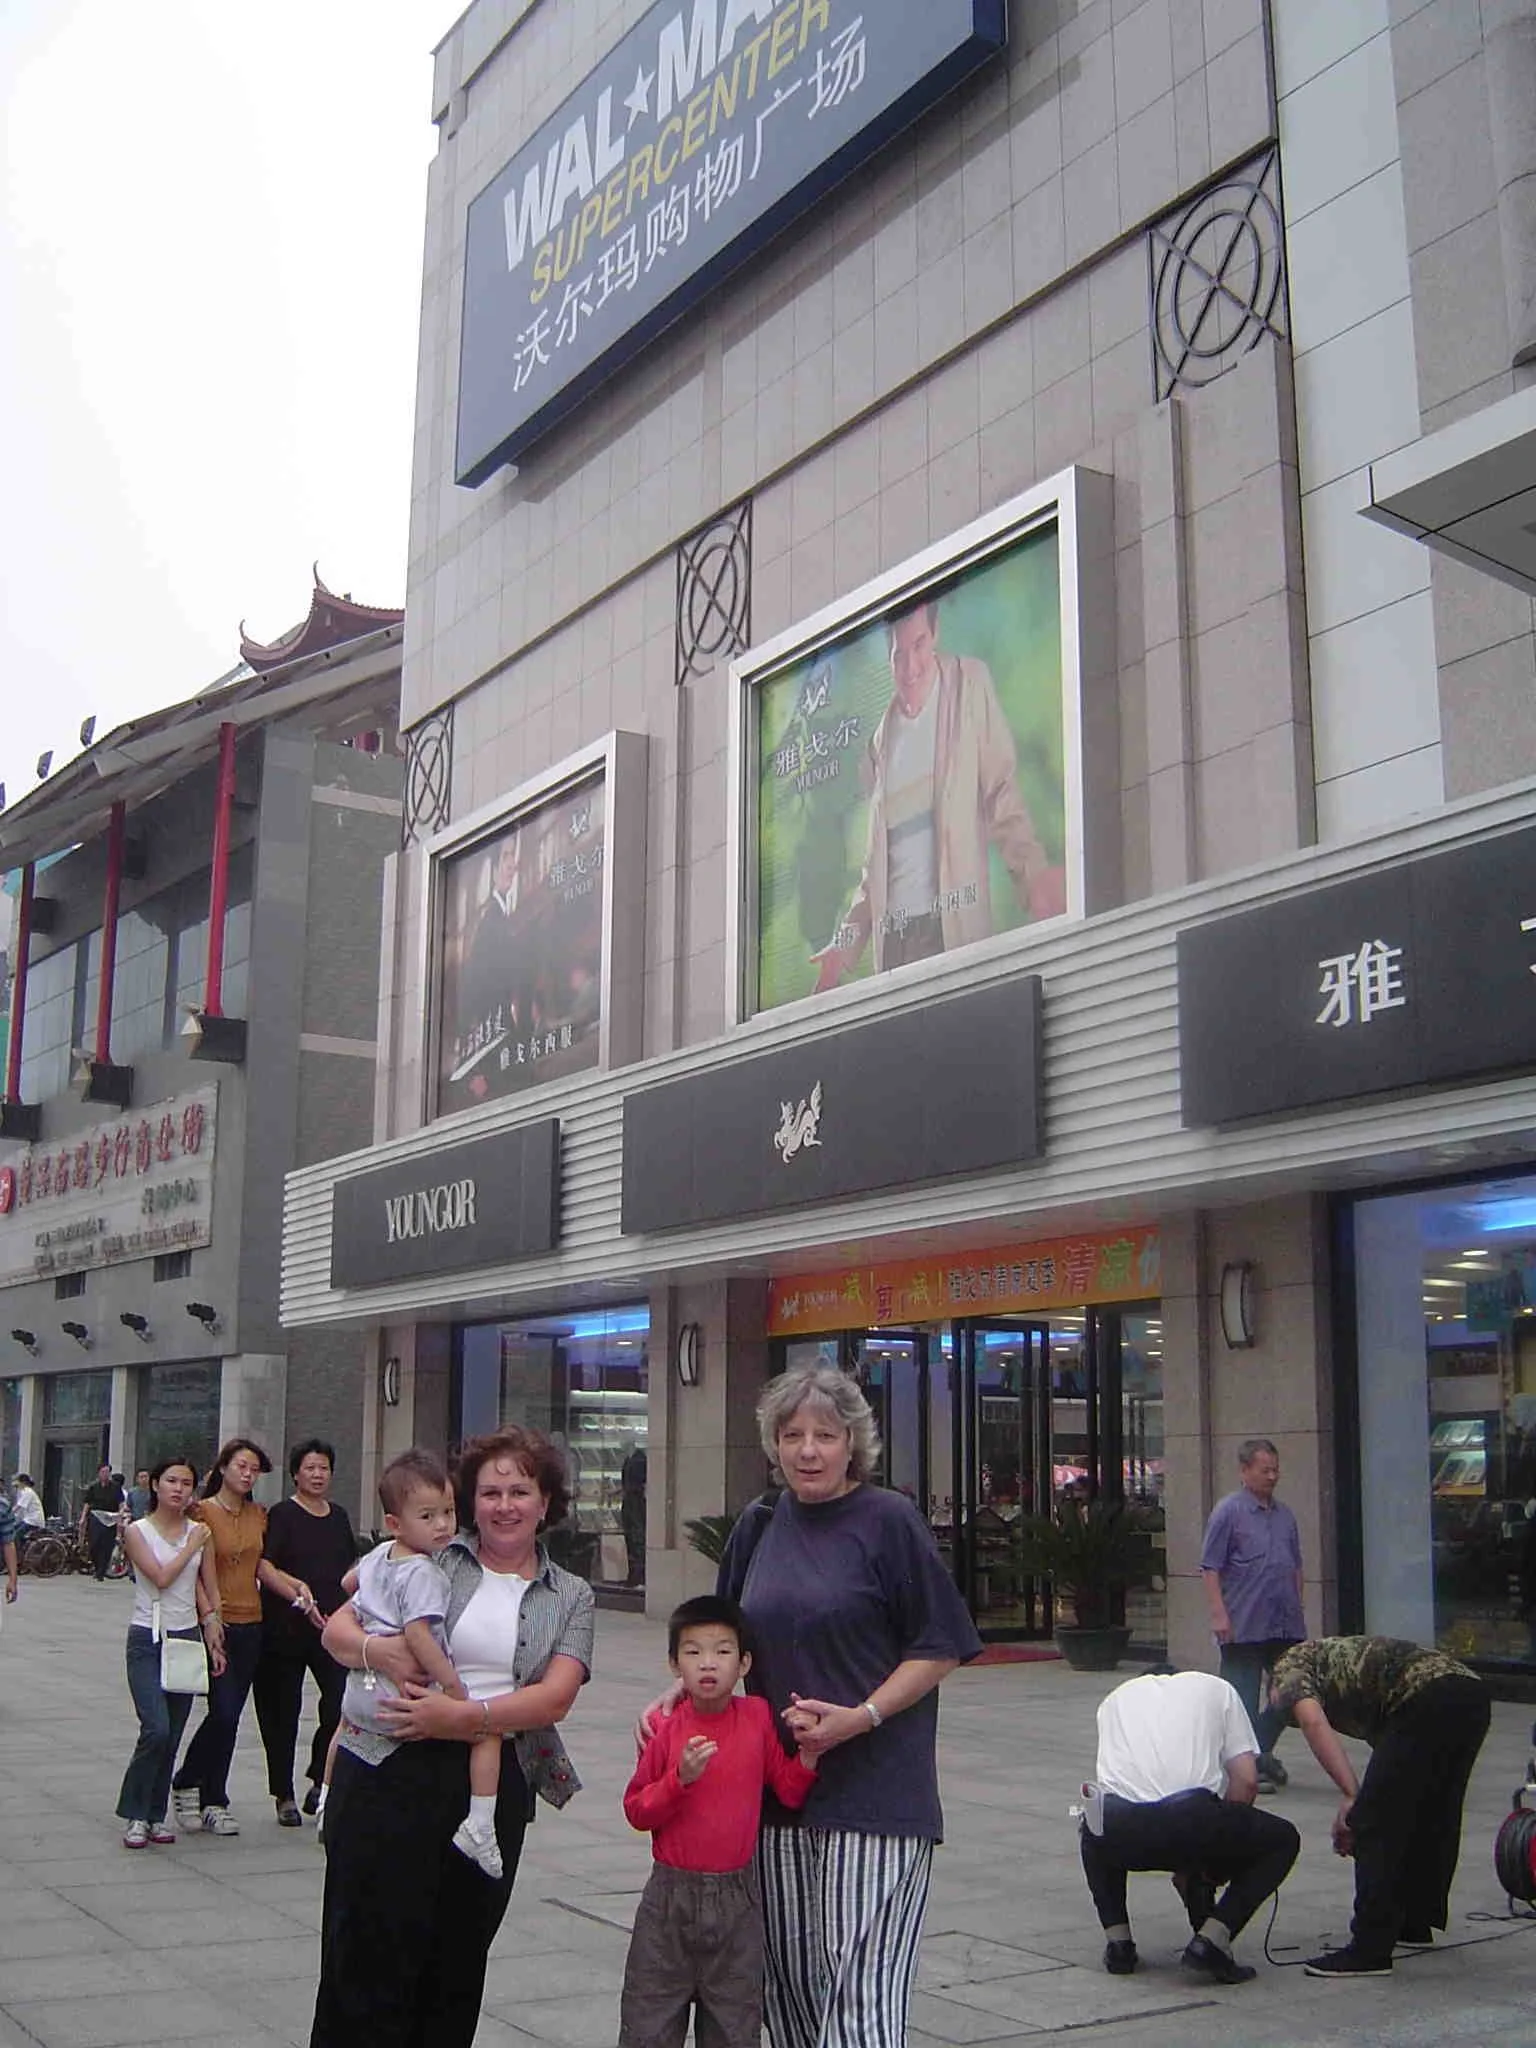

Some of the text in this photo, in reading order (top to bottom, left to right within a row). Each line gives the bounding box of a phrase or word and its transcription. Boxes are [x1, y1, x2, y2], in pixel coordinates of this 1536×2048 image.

[513, 15, 866, 392] 沃尔玛购物广场
[531, 0, 830, 304] SUPERCENTER
[385, 1179, 476, 1242] YOUNGOR
